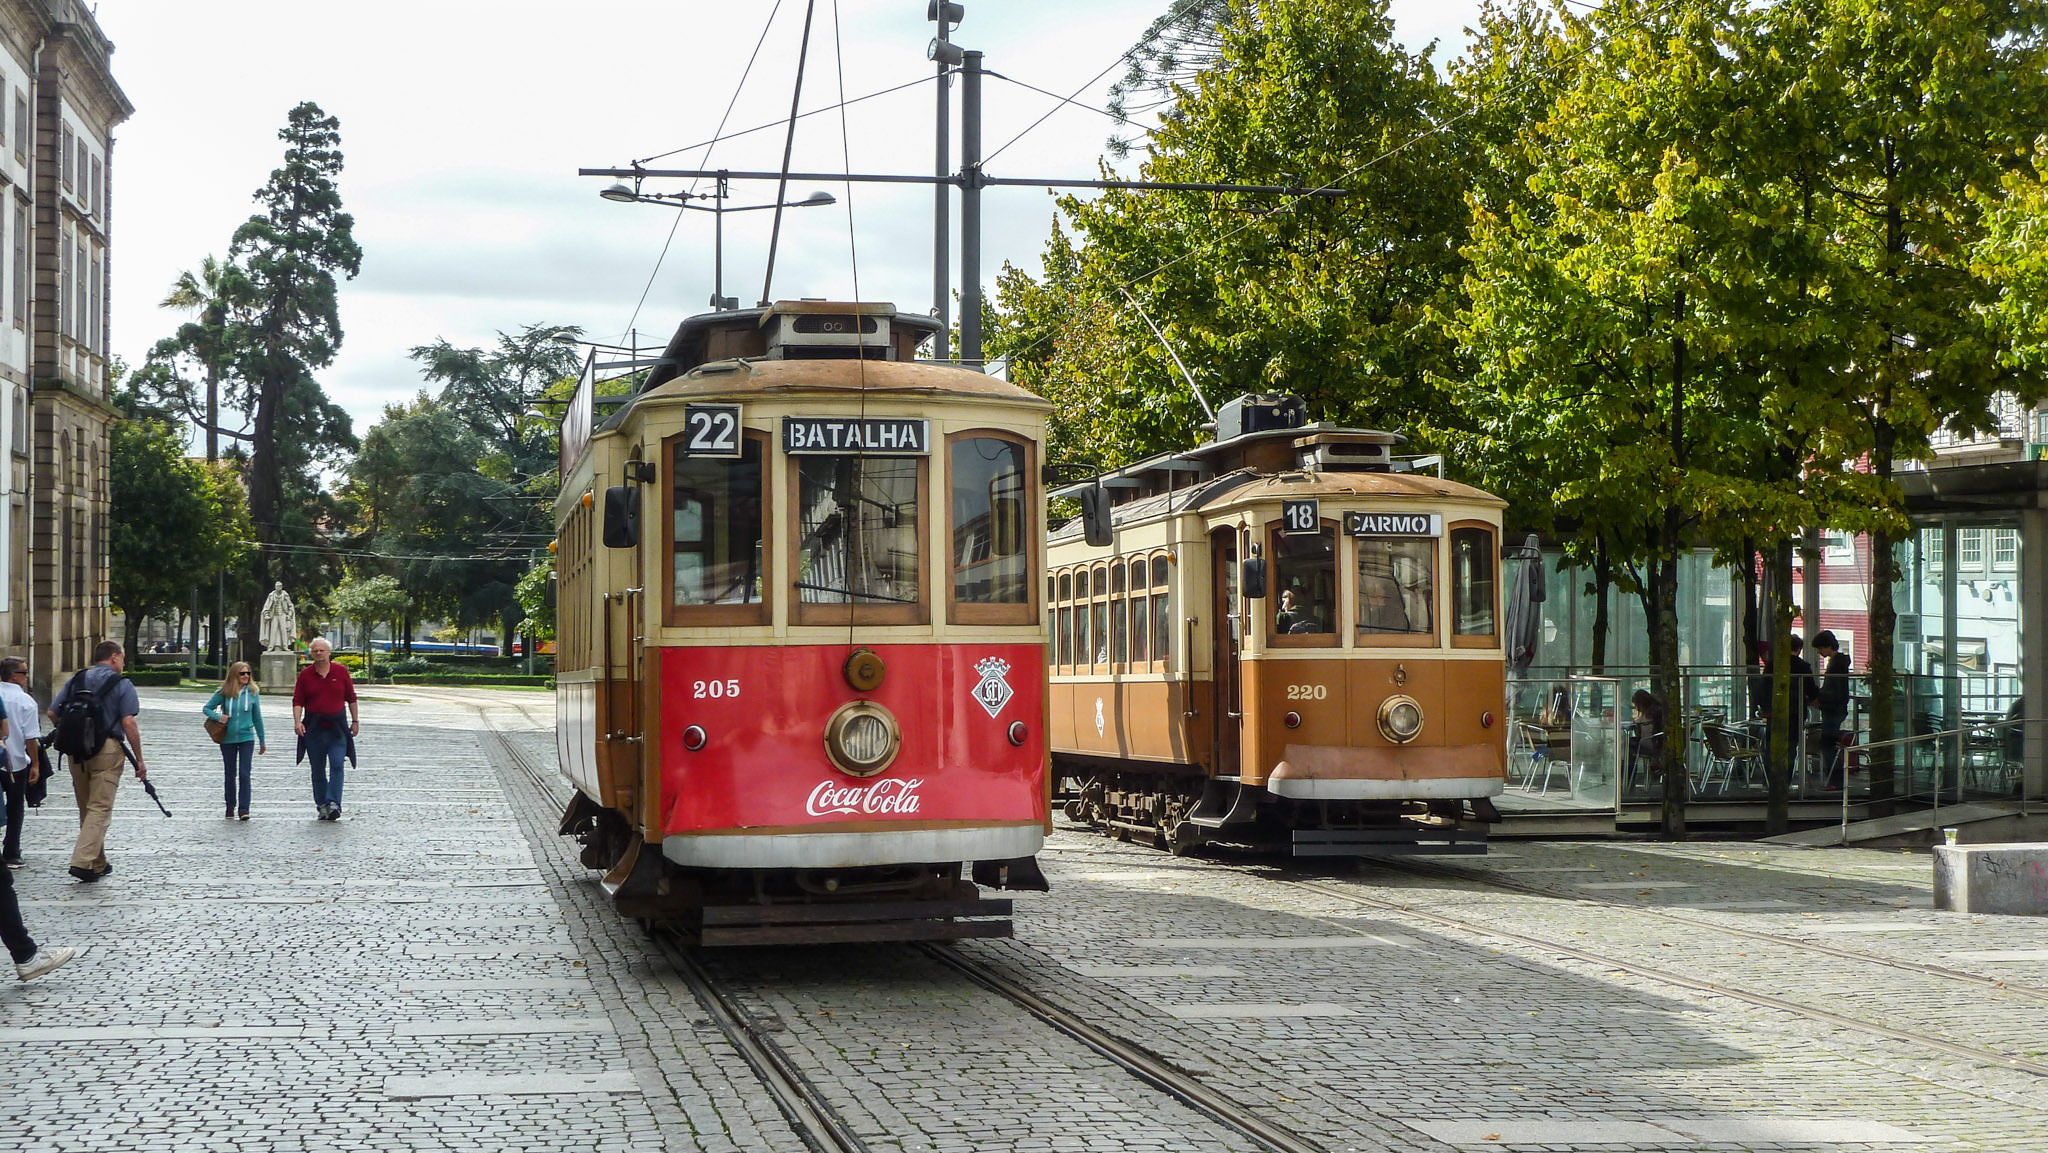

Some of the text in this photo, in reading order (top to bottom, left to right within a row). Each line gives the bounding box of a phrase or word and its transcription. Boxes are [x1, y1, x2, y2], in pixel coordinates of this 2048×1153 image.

[689, 412, 735, 449] 22
[790, 423, 918, 448] BATALHA
[1286, 504, 1313, 529] 18
[1347, 516, 1427, 533] CARMO
[693, 679, 740, 699] 205
[1287, 684, 1327, 700] 220
[806, 778, 924, 816] Coca-Cola
